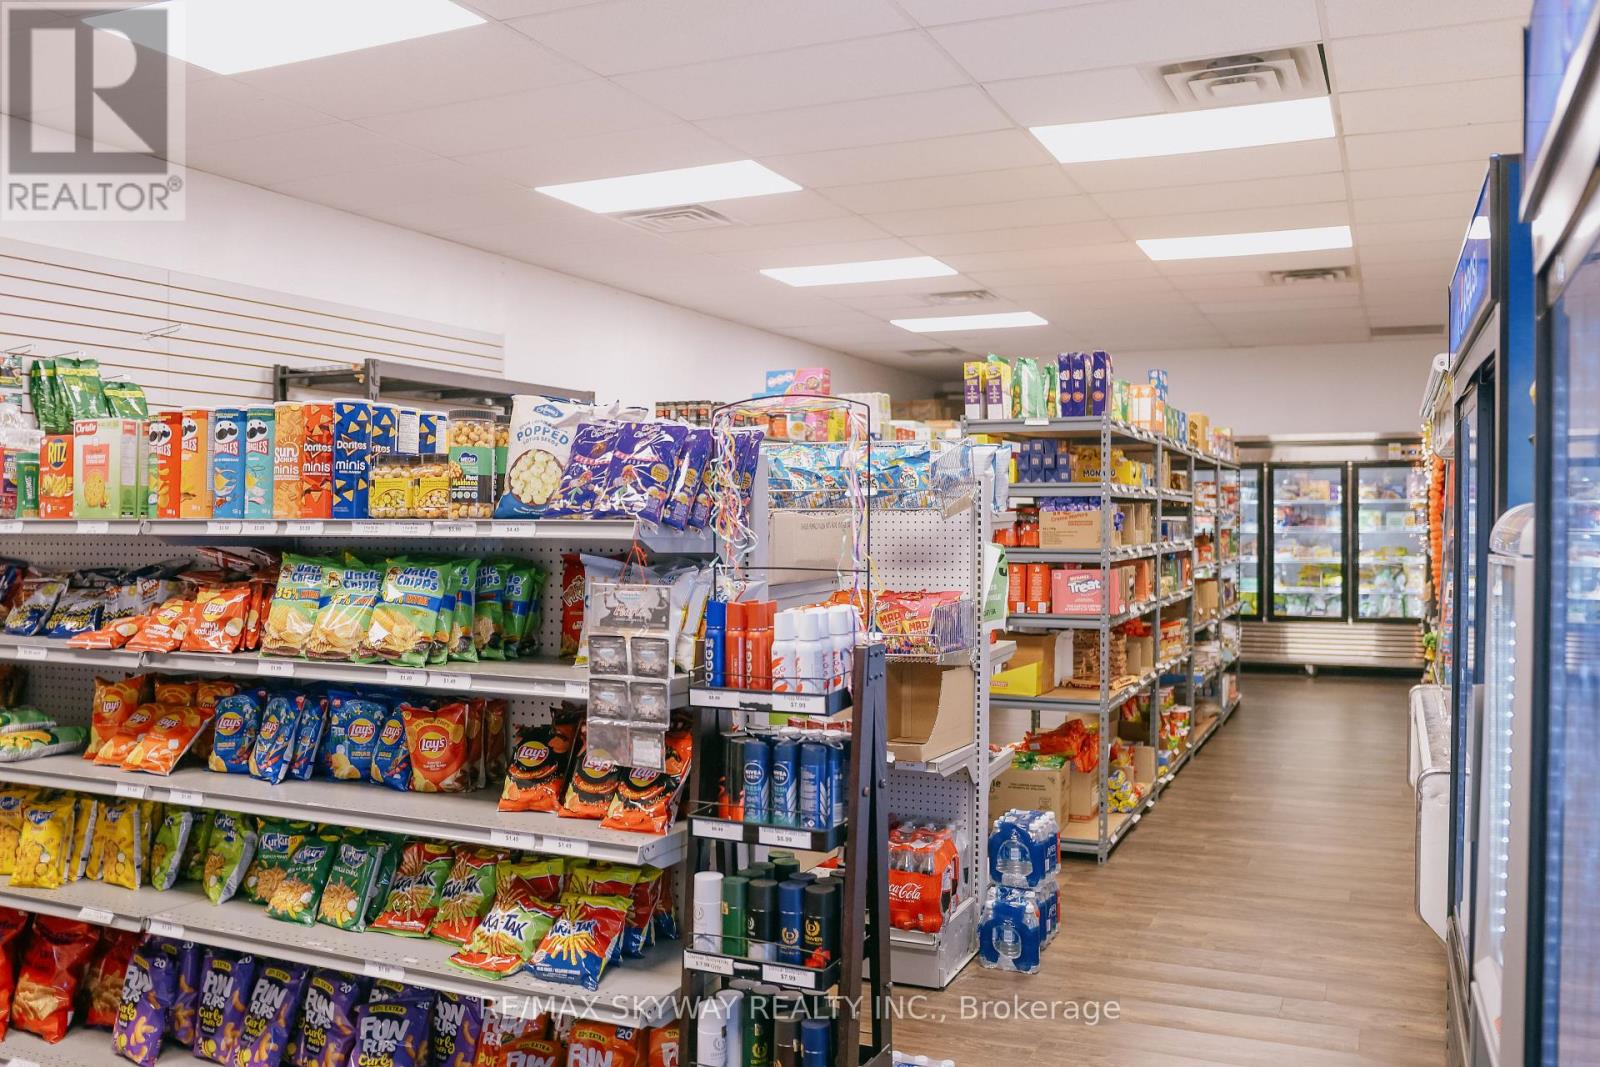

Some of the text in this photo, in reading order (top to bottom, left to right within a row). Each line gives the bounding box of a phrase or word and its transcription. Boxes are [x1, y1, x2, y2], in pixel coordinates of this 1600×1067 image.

[516, 425, 568, 445] POPPED
[303, 443, 332, 452] Doritos
[337, 440, 367, 450] Doritos
[47, 441, 68, 465] RITZ
[303, 462, 331, 472] minis
[336, 460, 366, 471] minis
[403, 566, 438, 579] Uncle
[397, 575, 439, 591] Chipps
[154, 958, 166, 969] 20
[340, 982, 352, 994] 20
[360, 1016, 410, 1041] FUN
